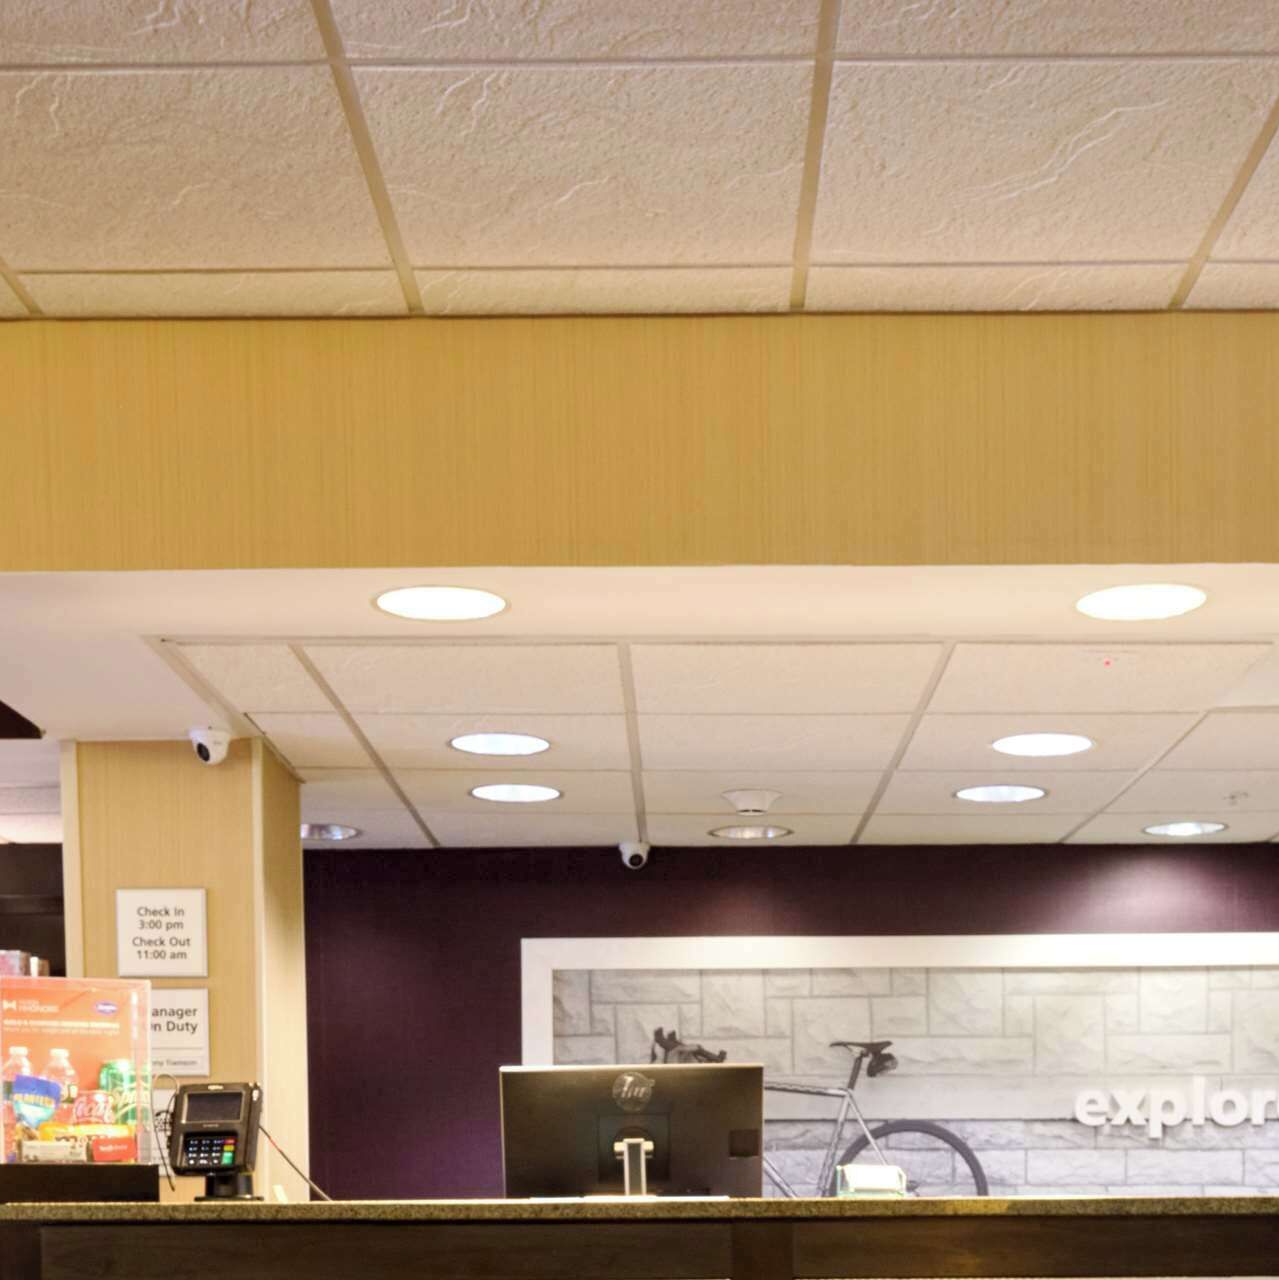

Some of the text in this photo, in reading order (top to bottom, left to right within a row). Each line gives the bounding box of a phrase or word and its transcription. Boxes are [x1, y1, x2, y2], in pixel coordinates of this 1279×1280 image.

[136, 906, 185, 917] Check In
[139, 919, 184, 932] 3:00 pm
[131, 936, 191, 947] Check Out
[137, 949, 187, 960] 11:00 am
[151, 1007, 197, 1020] anager
[166, 1020, 199, 1035] Duty
